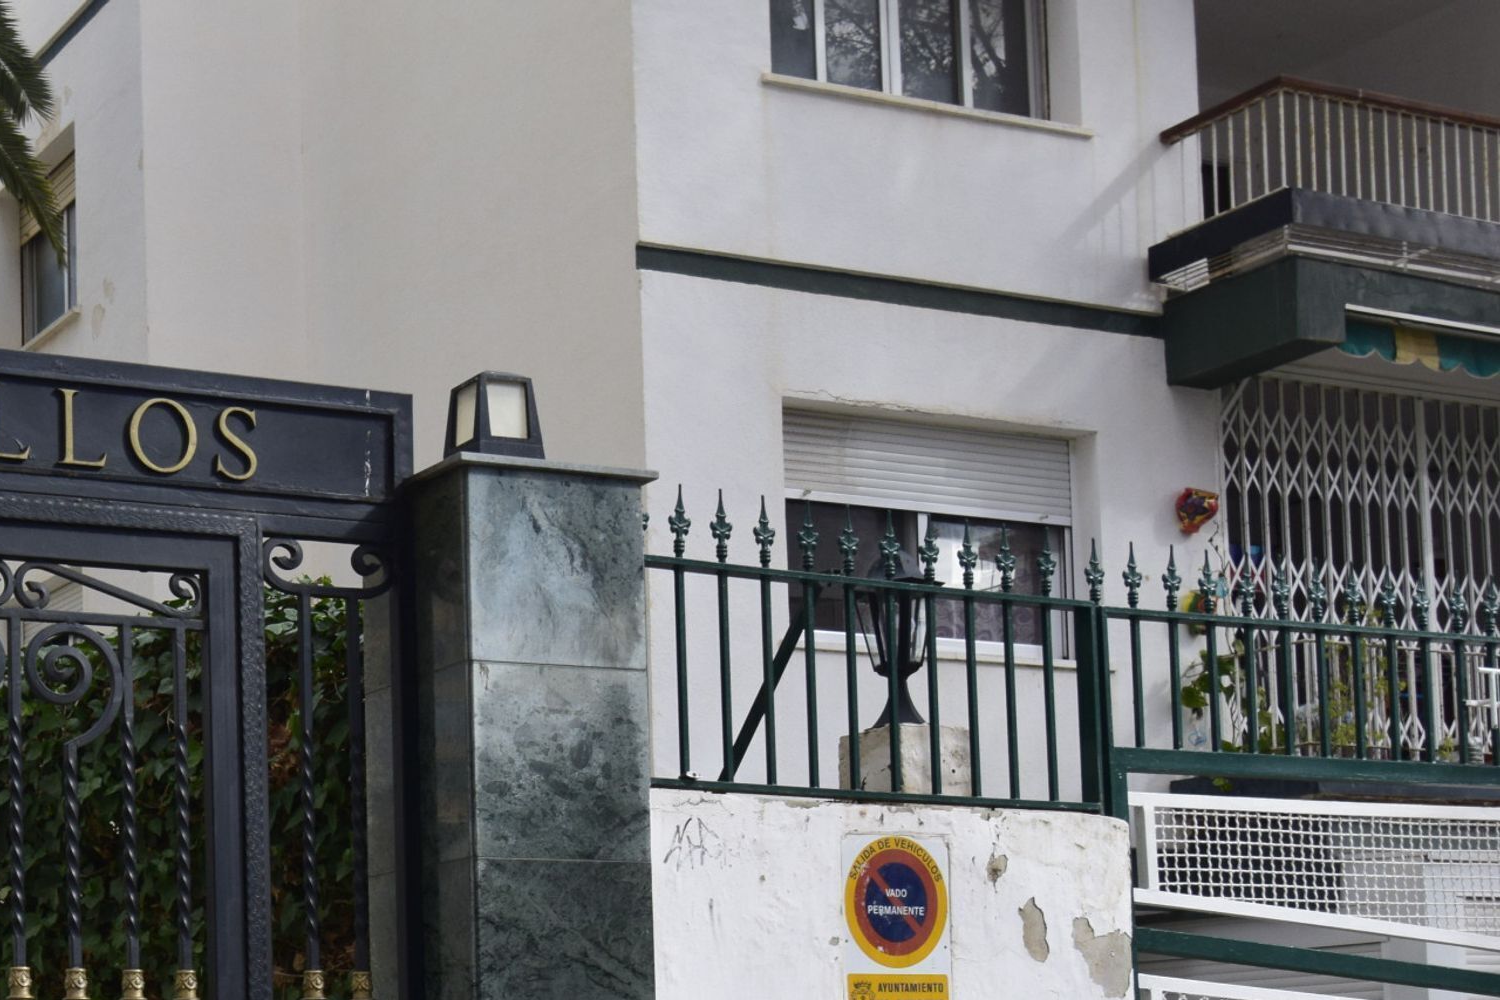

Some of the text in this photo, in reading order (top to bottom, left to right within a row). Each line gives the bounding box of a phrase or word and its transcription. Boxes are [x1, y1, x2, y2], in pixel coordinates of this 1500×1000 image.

[849, 838, 944, 883] SALIDA DE VEHICULOS
[884, 888, 908, 898] VADO
[866, 904, 925, 917] PERMANENTE
[877, 982, 944, 993] AYUNTAMIENTO
